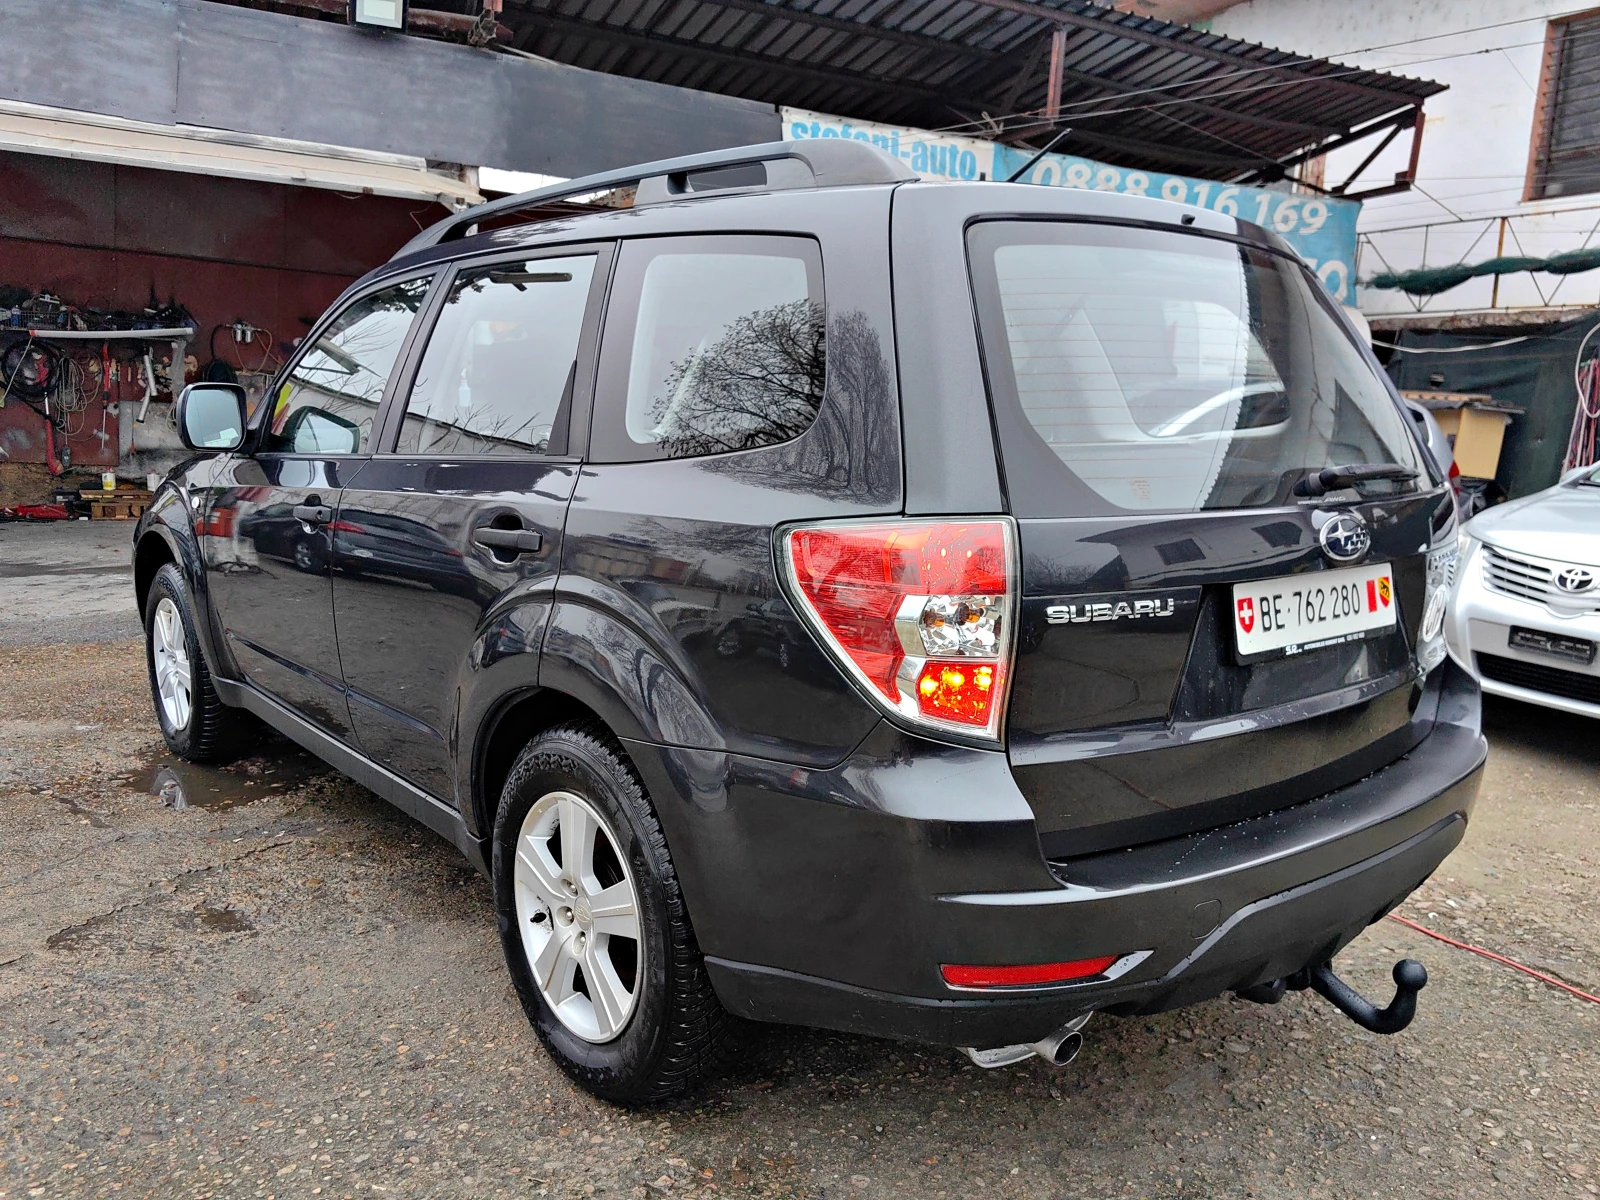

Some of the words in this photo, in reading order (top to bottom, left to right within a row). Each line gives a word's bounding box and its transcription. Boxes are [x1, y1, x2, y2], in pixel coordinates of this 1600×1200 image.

[1161, 179, 1240, 218] 916
[1255, 194, 1328, 235] 169
[1045, 598, 1175, 625] SUBARU
